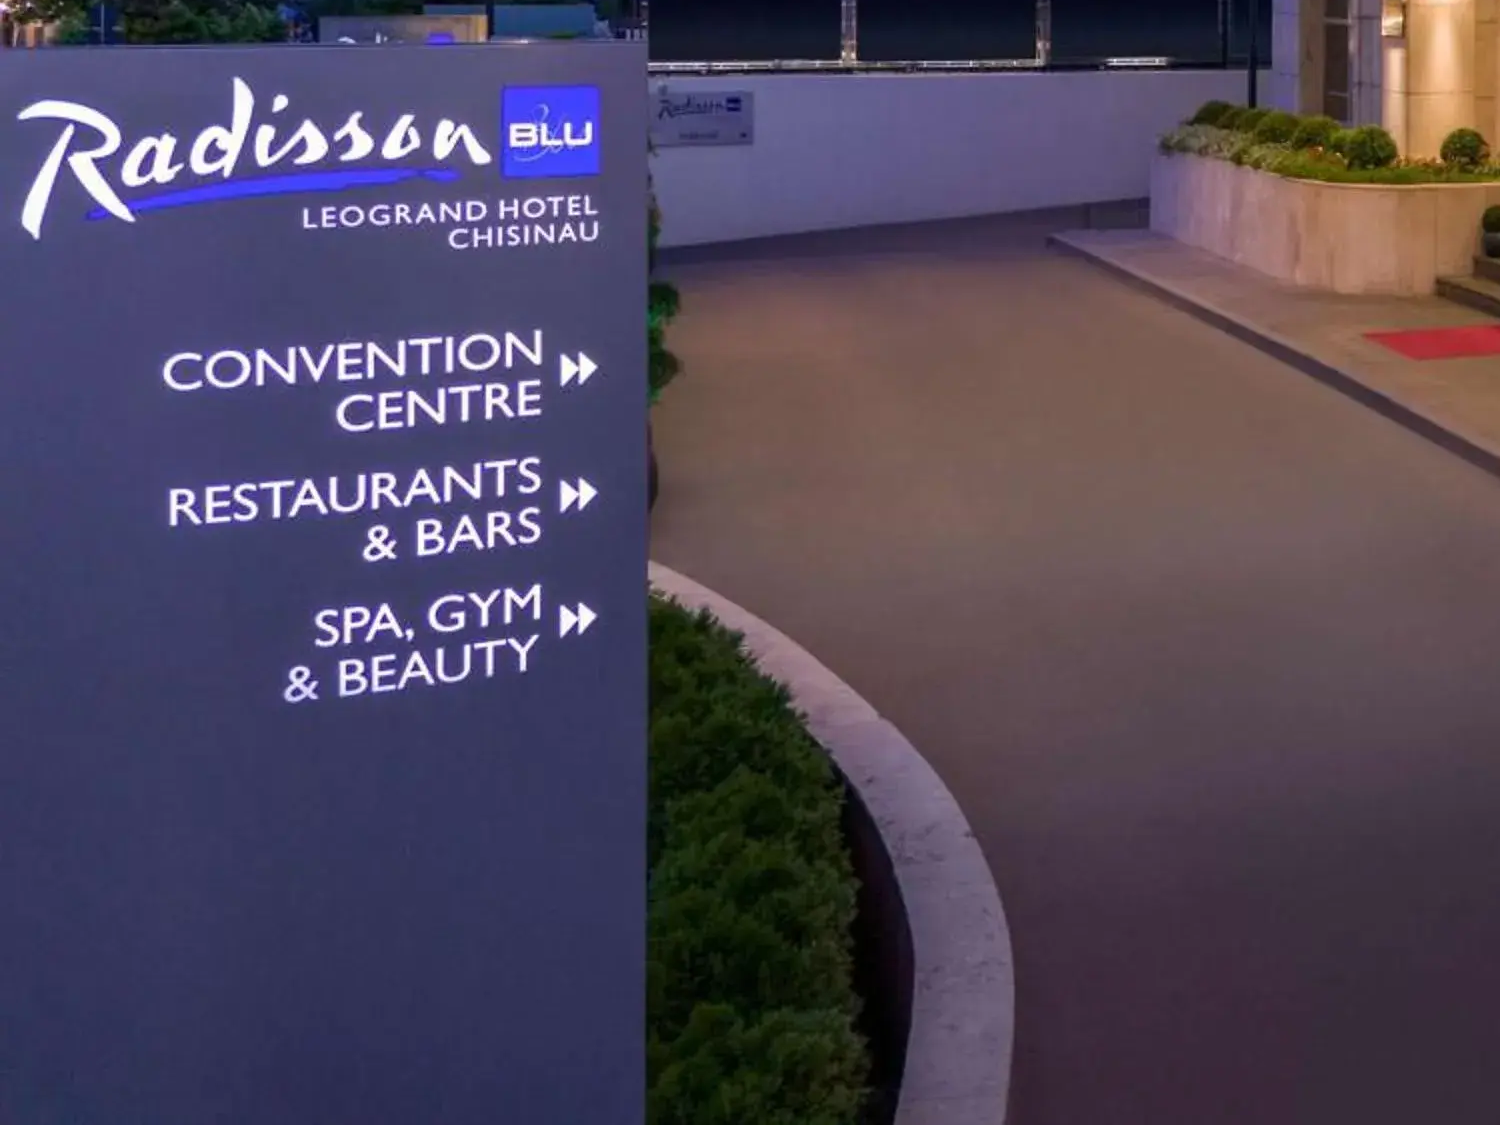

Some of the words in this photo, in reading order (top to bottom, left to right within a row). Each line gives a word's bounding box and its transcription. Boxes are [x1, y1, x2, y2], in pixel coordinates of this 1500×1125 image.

[17, 76, 493, 240] Radisson
[508, 121, 594, 148] BLU
[302, 198, 488, 230] LEOGRAND
[498, 194, 599, 220] HOTEL
[448, 221, 600, 250] CHISINAU
[162, 329, 542, 392] CONVENTION
[335, 379, 542, 433] CENTRE
[168, 456, 542, 527] RESTAURANTS
[362, 524, 397, 562] &
[416, 506, 542, 557] BARS
[315, 602, 415, 648] SPA,
[428, 583, 542, 633] GYM
[284, 665, 318, 703] &
[339, 634, 540, 698] BEAUTY
